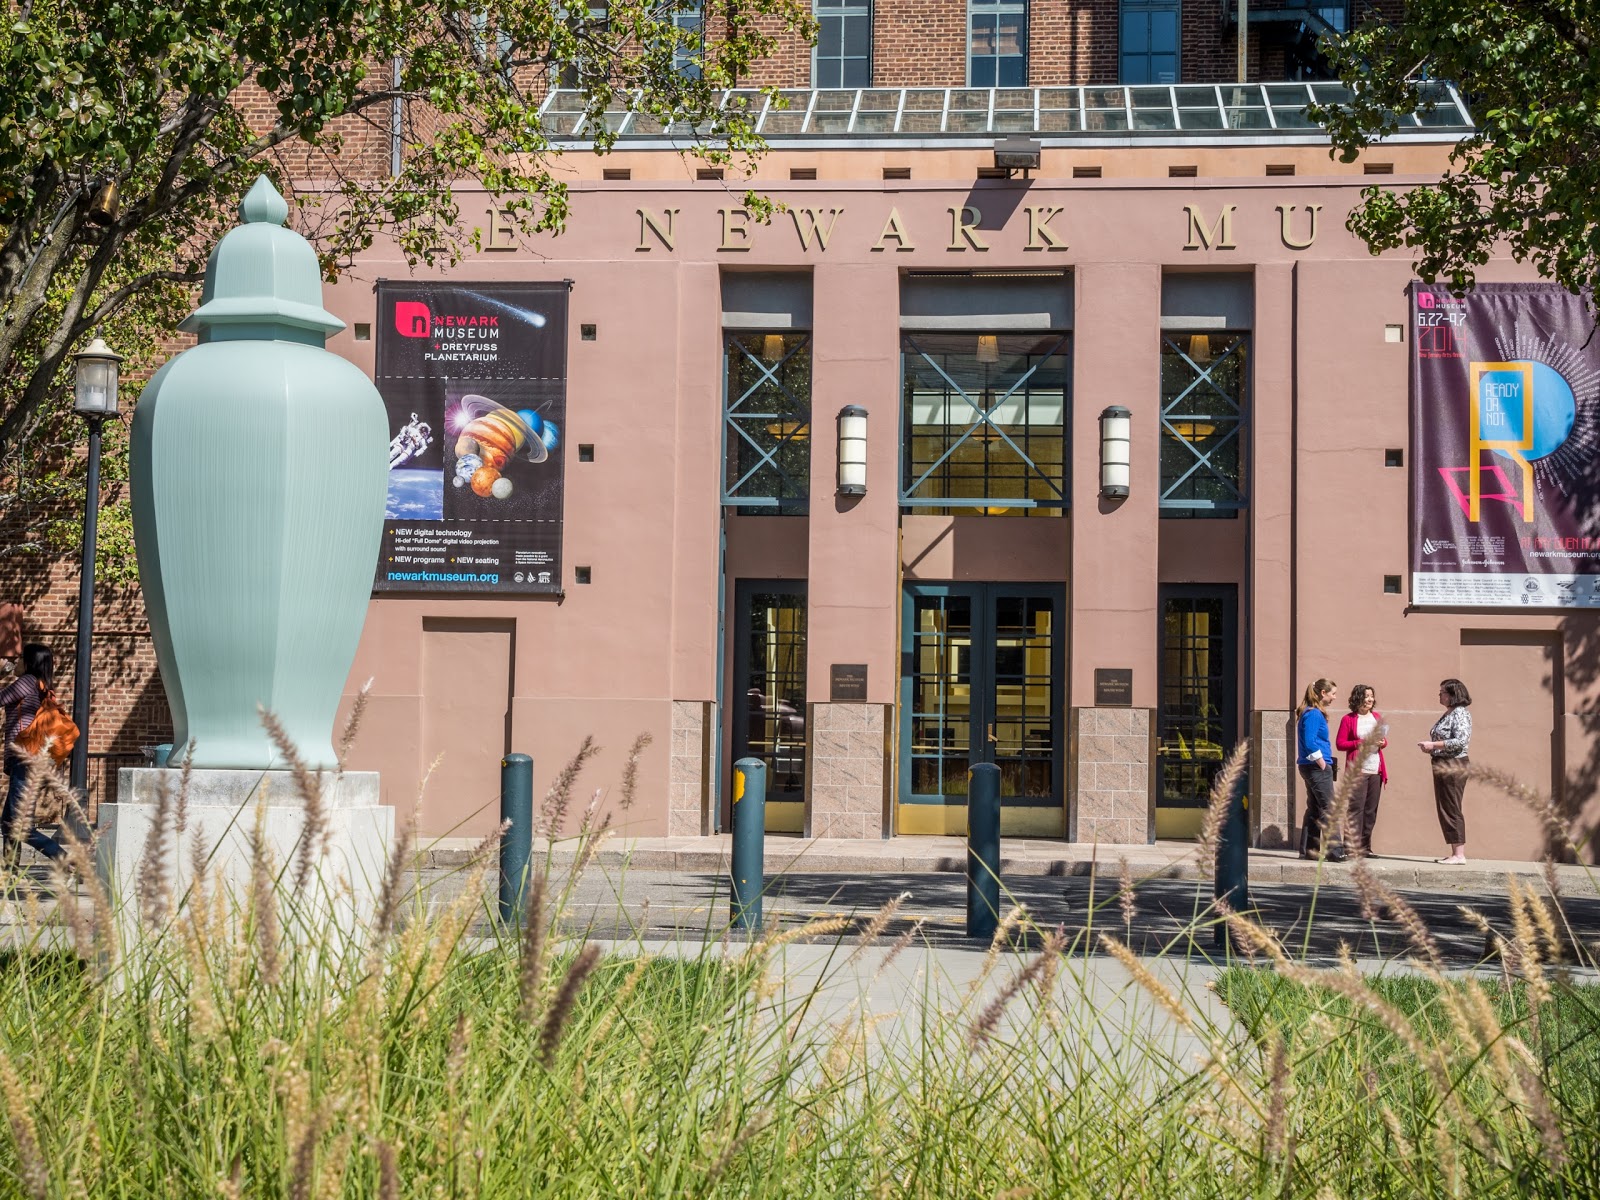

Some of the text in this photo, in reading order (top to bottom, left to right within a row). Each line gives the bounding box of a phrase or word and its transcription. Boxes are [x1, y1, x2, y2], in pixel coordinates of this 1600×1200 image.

[635, 206, 1070, 253] NEWARK
[435, 316, 499, 326] NEWARK
[434, 328, 499, 339] MUSEUM
[1417, 326, 1467, 352] 2014
[424, 353, 498, 361] PLANETARIUM
[1485, 383, 1519, 398] READY
[1485, 397, 1499, 412] OR
[1486, 412, 1506, 426] NOT
[413, 529, 434, 537] digital
[456, 556, 474, 564] NEW
[475, 557, 499, 565] seating
[387, 571, 499, 584] newarkmuseum.org
